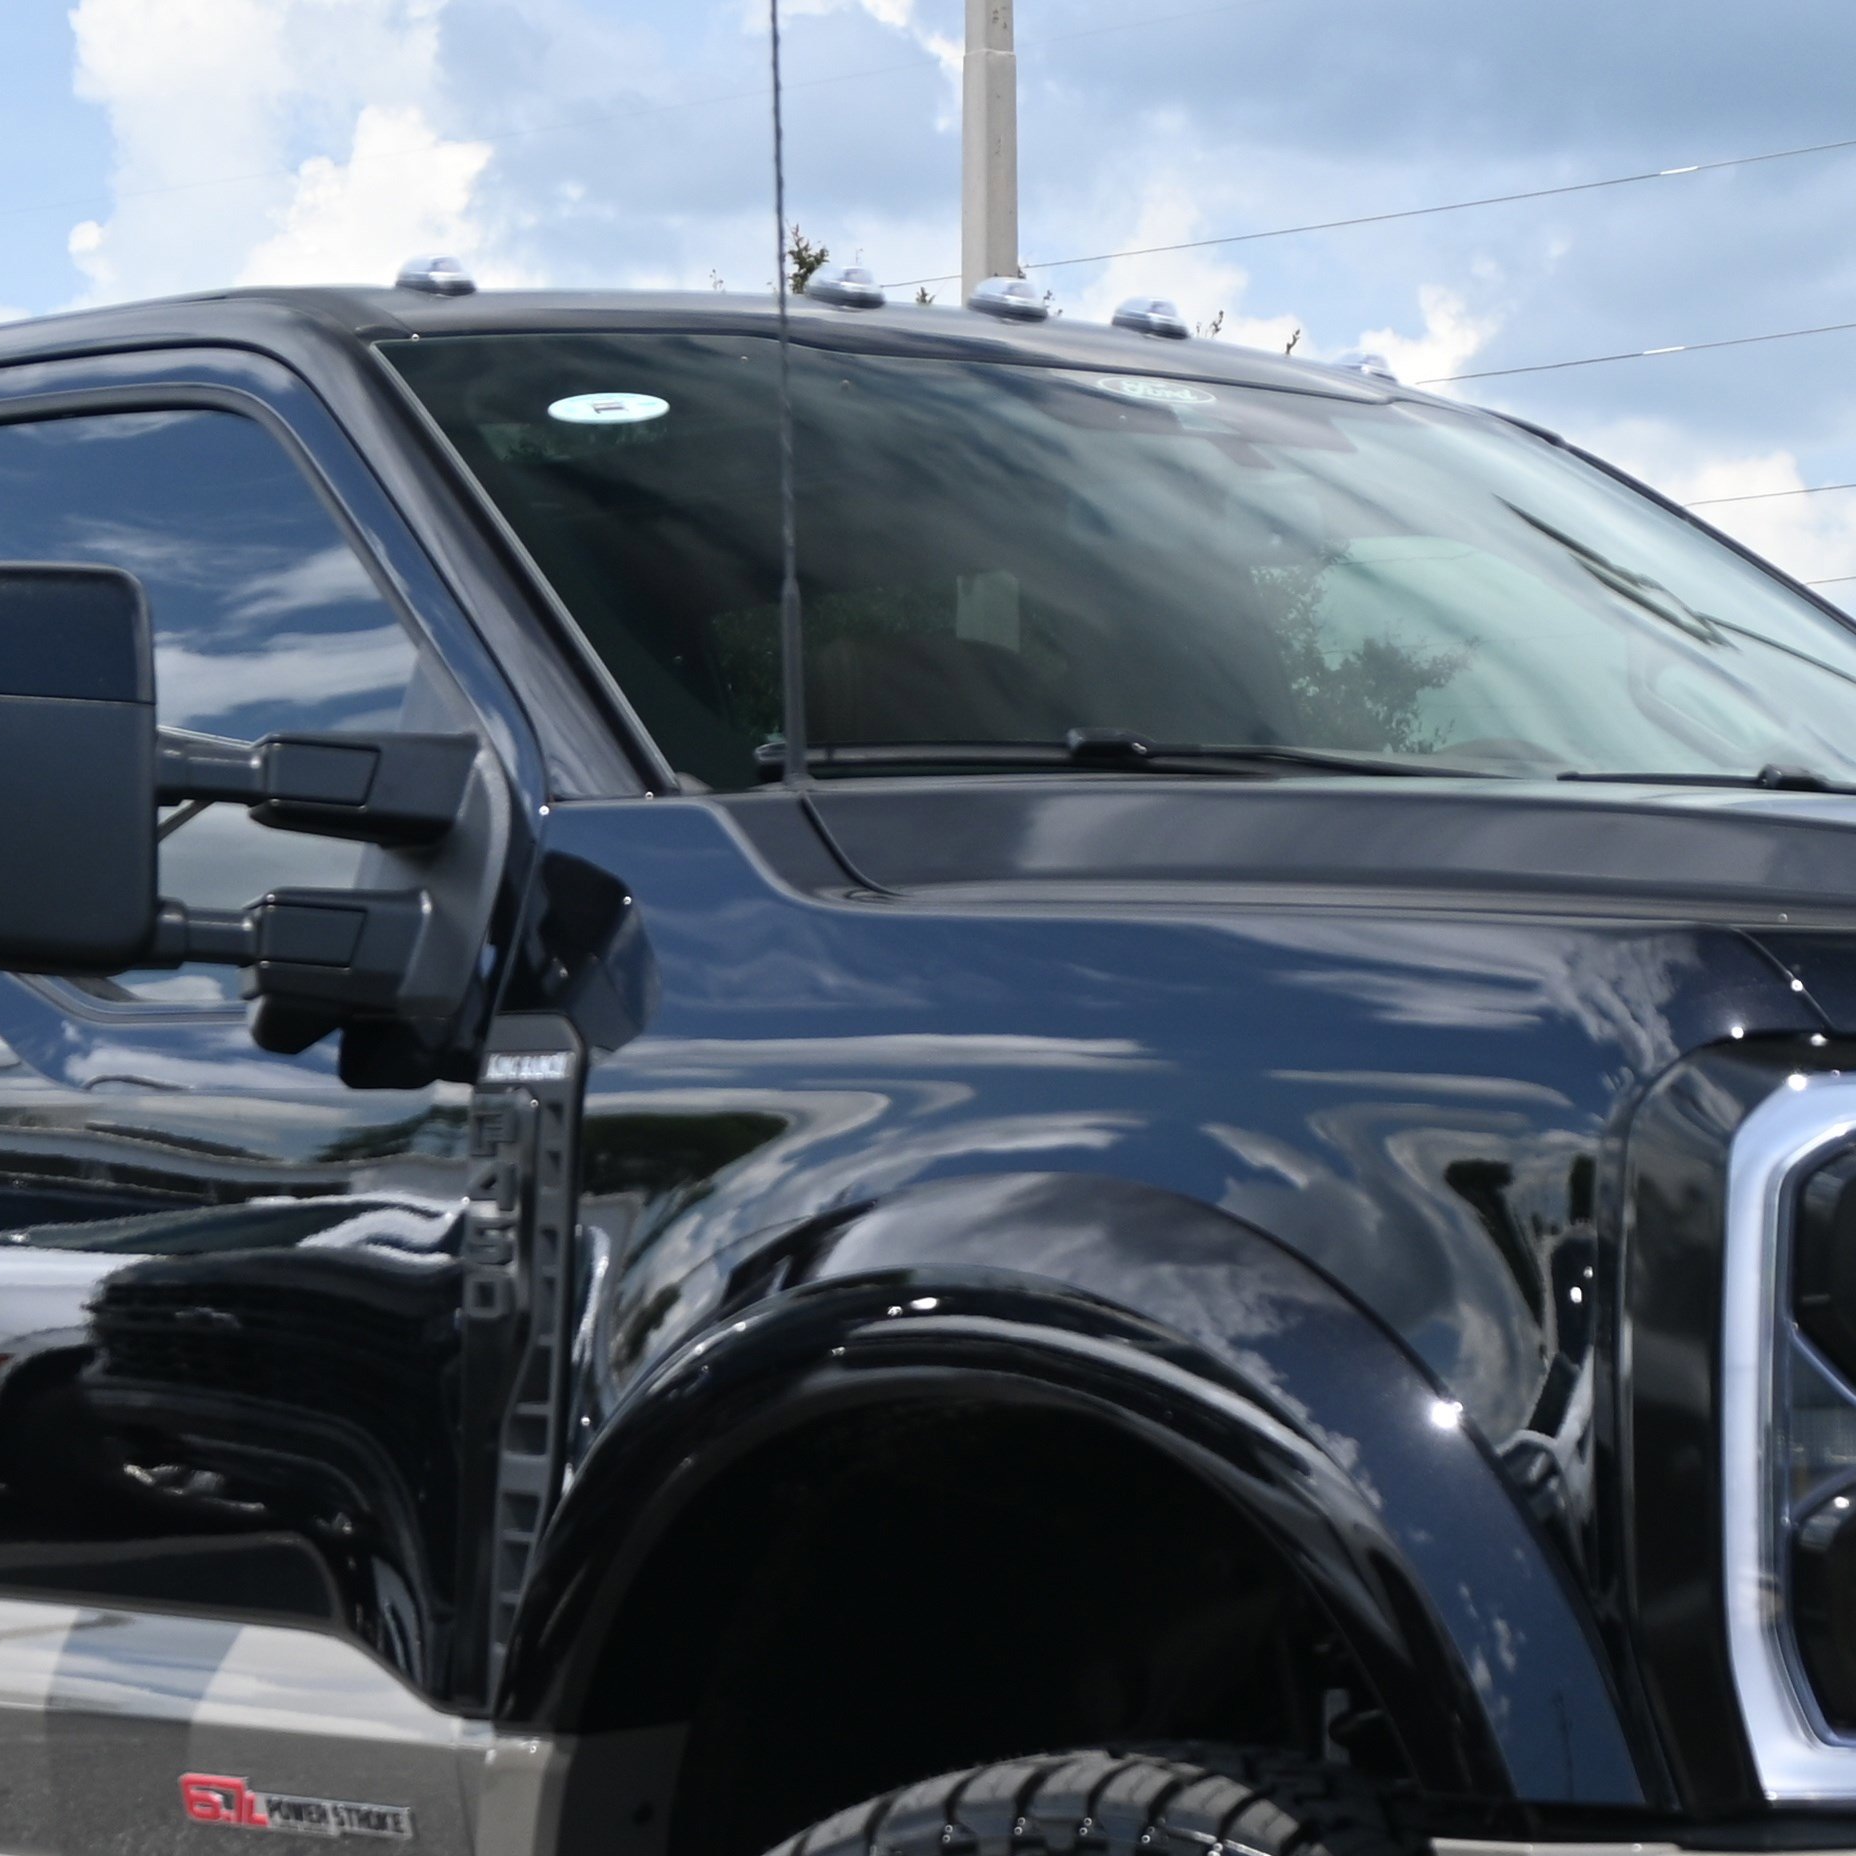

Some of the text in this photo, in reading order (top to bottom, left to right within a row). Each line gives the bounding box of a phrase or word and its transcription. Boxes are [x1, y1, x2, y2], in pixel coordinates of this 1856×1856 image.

[178, 1772, 406, 1835] 6.7L POWER STROKE
